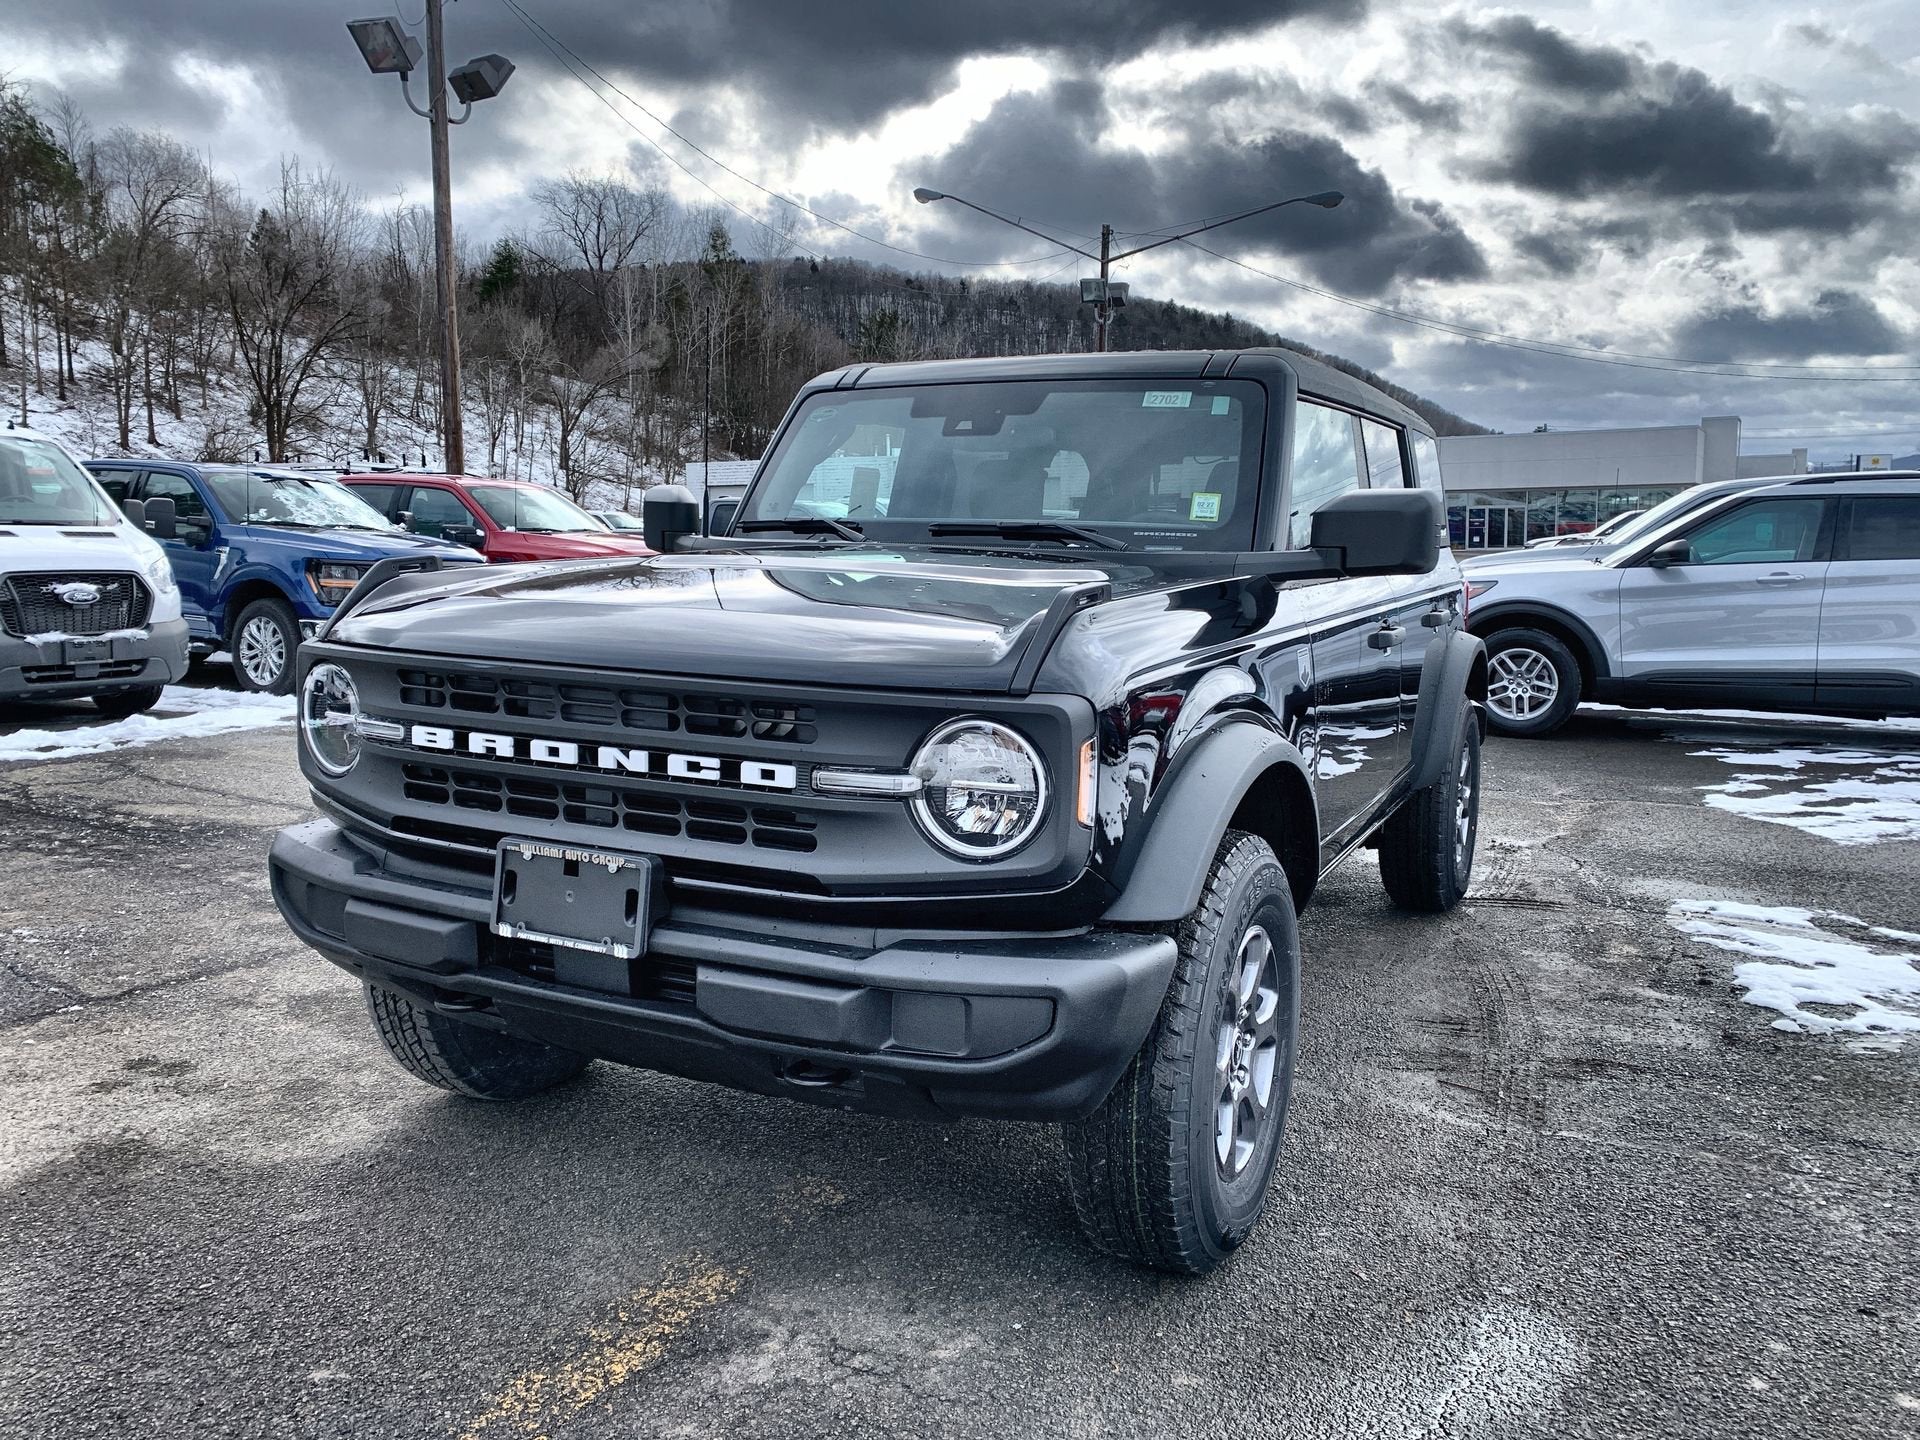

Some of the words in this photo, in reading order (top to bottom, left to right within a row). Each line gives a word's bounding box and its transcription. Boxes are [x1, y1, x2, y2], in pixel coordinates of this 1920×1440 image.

[1151, 394, 1180, 405] 2702
[411, 725, 797, 789] BRONCO
[565, 849, 590, 862] AUTO
[549, 938, 563, 946] WITH
[564, 940, 574, 948] THE
